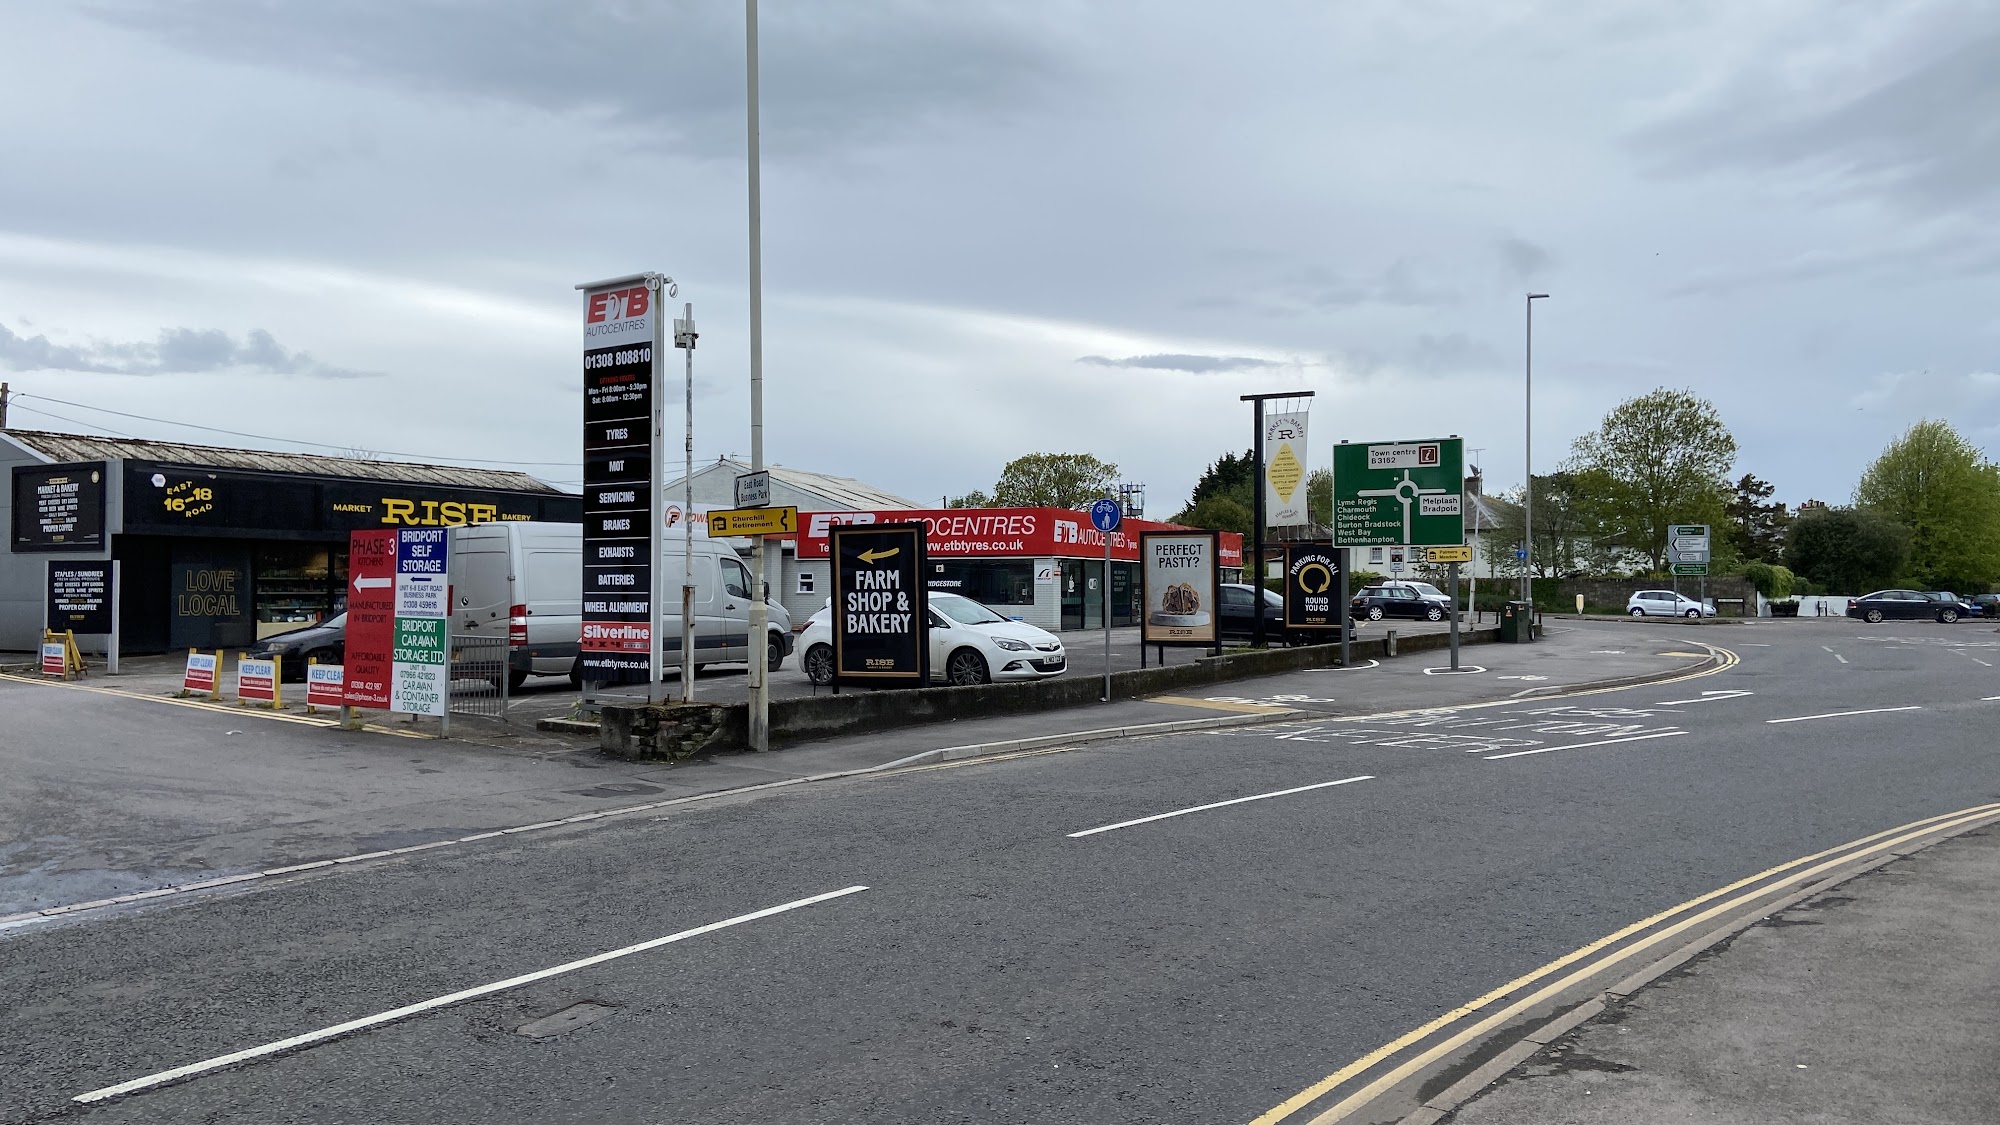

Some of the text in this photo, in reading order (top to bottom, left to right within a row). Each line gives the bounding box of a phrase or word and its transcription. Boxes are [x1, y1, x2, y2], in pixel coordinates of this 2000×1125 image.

[586, 319, 645, 338] AUTOCENTRES
[585, 348, 651, 370] 01308 808810
[606, 428, 628, 440] TYRES
[1268, 419, 1282, 441] MARKET
[1290, 419, 1304, 438] BAKERY
[1278, 430, 1295, 439] R
[609, 460, 624, 473] MOT
[38, 484, 56, 494] MARKET
[167, 481, 192, 495] EAST
[744, 477, 763, 489] East Road
[599, 490, 635, 504] SERVICING
[741, 490, 767, 502] Business Park
[186, 504, 213, 518] ROAD
[333, 504, 372, 513] MARKET
[381, 498, 496, 526] RISE
[603, 518, 630, 531] BRAKES
[402, 530, 443, 543] BRIDPORT
[1053, 519, 1078, 543] ETB
[1078, 528, 1125, 548] AUTOCETRES
[352, 538, 395, 556] PHASE 3
[412, 545, 432, 558] SELF
[599, 546, 634, 558] EXHAUSTS
[1156, 544, 1203, 556] PERFECT
[402, 560, 441, 572] STORAGE
[1158, 557, 1200, 568] PASTY?
[1290, 555, 1339, 575] PARKING FOR ALL
[187, 570, 235, 592] LOVE
[598, 573, 635, 586] BATTERIES
[855, 570, 899, 590] FARM
[179, 594, 240, 616] LOCAL
[349, 601, 393, 610] MANUFACTURED
[584, 601, 648, 614] WHEEL ALIGNMENT
[848, 592, 909, 612] SHOP &
[361, 614, 387, 623] BRIDPORT
[848, 614, 911, 633] BAKERY
[401, 619, 438, 632] BRIDPORT
[584, 625, 649, 639] Silverline
[401, 634, 438, 648] CARAVAN
[352, 652, 386, 662] AFFORDABLE
[394, 650, 444, 662] STORAGE LTD
[190, 658, 213, 668] KEEP CLEAR
[242, 665, 271, 675] KEEP CLEAR
[312, 669, 325, 679] KEEP
[356, 665, 380, 675] QUALITY
[402, 680, 433, 692] CARAVAN
[395, 690, 439, 703] & CONTAINER
[402, 702, 431, 713] STORAGE
